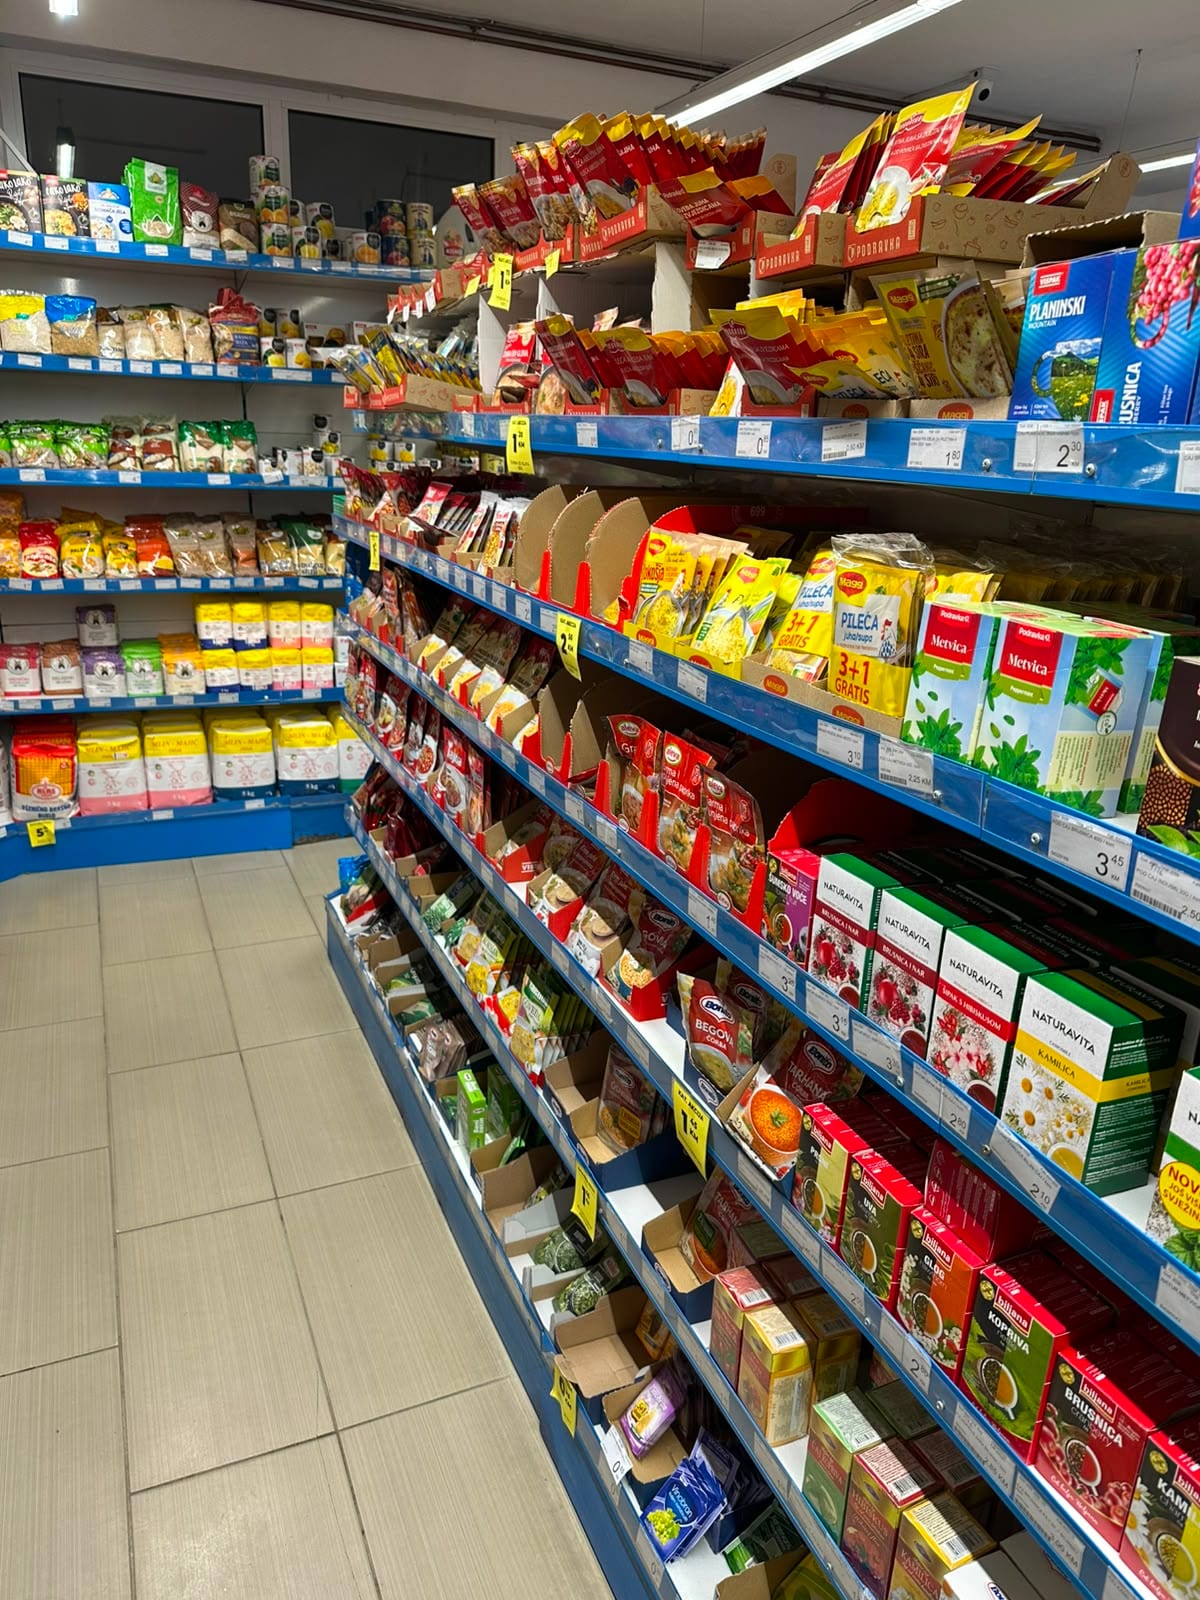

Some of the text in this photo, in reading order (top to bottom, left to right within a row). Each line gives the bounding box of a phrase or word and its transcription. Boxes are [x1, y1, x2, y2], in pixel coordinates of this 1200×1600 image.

[765, 250, 800, 270] PODRAVKA
[856, 236, 901, 259] PODRAVKA
[1039, 274, 1061, 286] VISPAK
[1028, 295, 1087, 322] PLANINSKI
[1028, 319, 1057, 330] MOUNTAIN
[1119, 361, 1142, 425] USNICA
[1056, 444, 1070, 468] 2
[1071, 441, 1082, 451] 30
[787, 612, 820, 634] 3+1
[841, 611, 879, 632] PILEĆA
[778, 634, 810, 648] GRATIS
[931, 634, 968, 655] Metvica
[838, 651, 871, 686] 3+1
[1007, 651, 1048, 676] Metvica
[835, 677, 870, 706] GRATIS
[847, 750, 854, 764] 3
[908, 774, 932, 786] 2.25 KM
[1095, 852, 1109, 876] 3
[1111, 854, 1125, 867] 45
[823, 881, 864, 912] NATURAVITA
[822, 908, 846, 928] BRUSNICA
[885, 916, 931, 951] NATURAVITA
[883, 945, 909, 967] BRUSNICA
[949, 958, 1004, 1000] NATURAVITA
[941, 985, 958, 1002] ŠIPAK
[963, 1000, 1001, 1032] HIBISKUSOM
[695, 1018, 734, 1046] BEGOVA
[832, 1014, 840, 1032] 3
[1032, 1008, 1096, 1056] NATURAVITA
[1037, 1048, 1076, 1080] KAMILICA
[788, 1060, 829, 1104] TARHANA
[681, 1108, 688, 1135] 1
[950, 1113, 958, 1128] 2
[1188, 1110, 1200, 1125] N
[862, 1176, 884, 1202] biljana
[1030, 1183, 1041, 1200] 2
[863, 1199, 878, 1218] UVA
[925, 1234, 952, 1264] biljana
[924, 1254, 946, 1281] GLOG
[996, 1294, 1029, 1328] biljana
[987, 1310, 1031, 1355] KOPRIVA
[909, 1359, 920, 1377] 2
[1081, 1382, 1115, 1416] biljana
[1064, 1386, 1124, 1449] BRUSNICA
[671, 1483, 693, 1519] Vinobran
